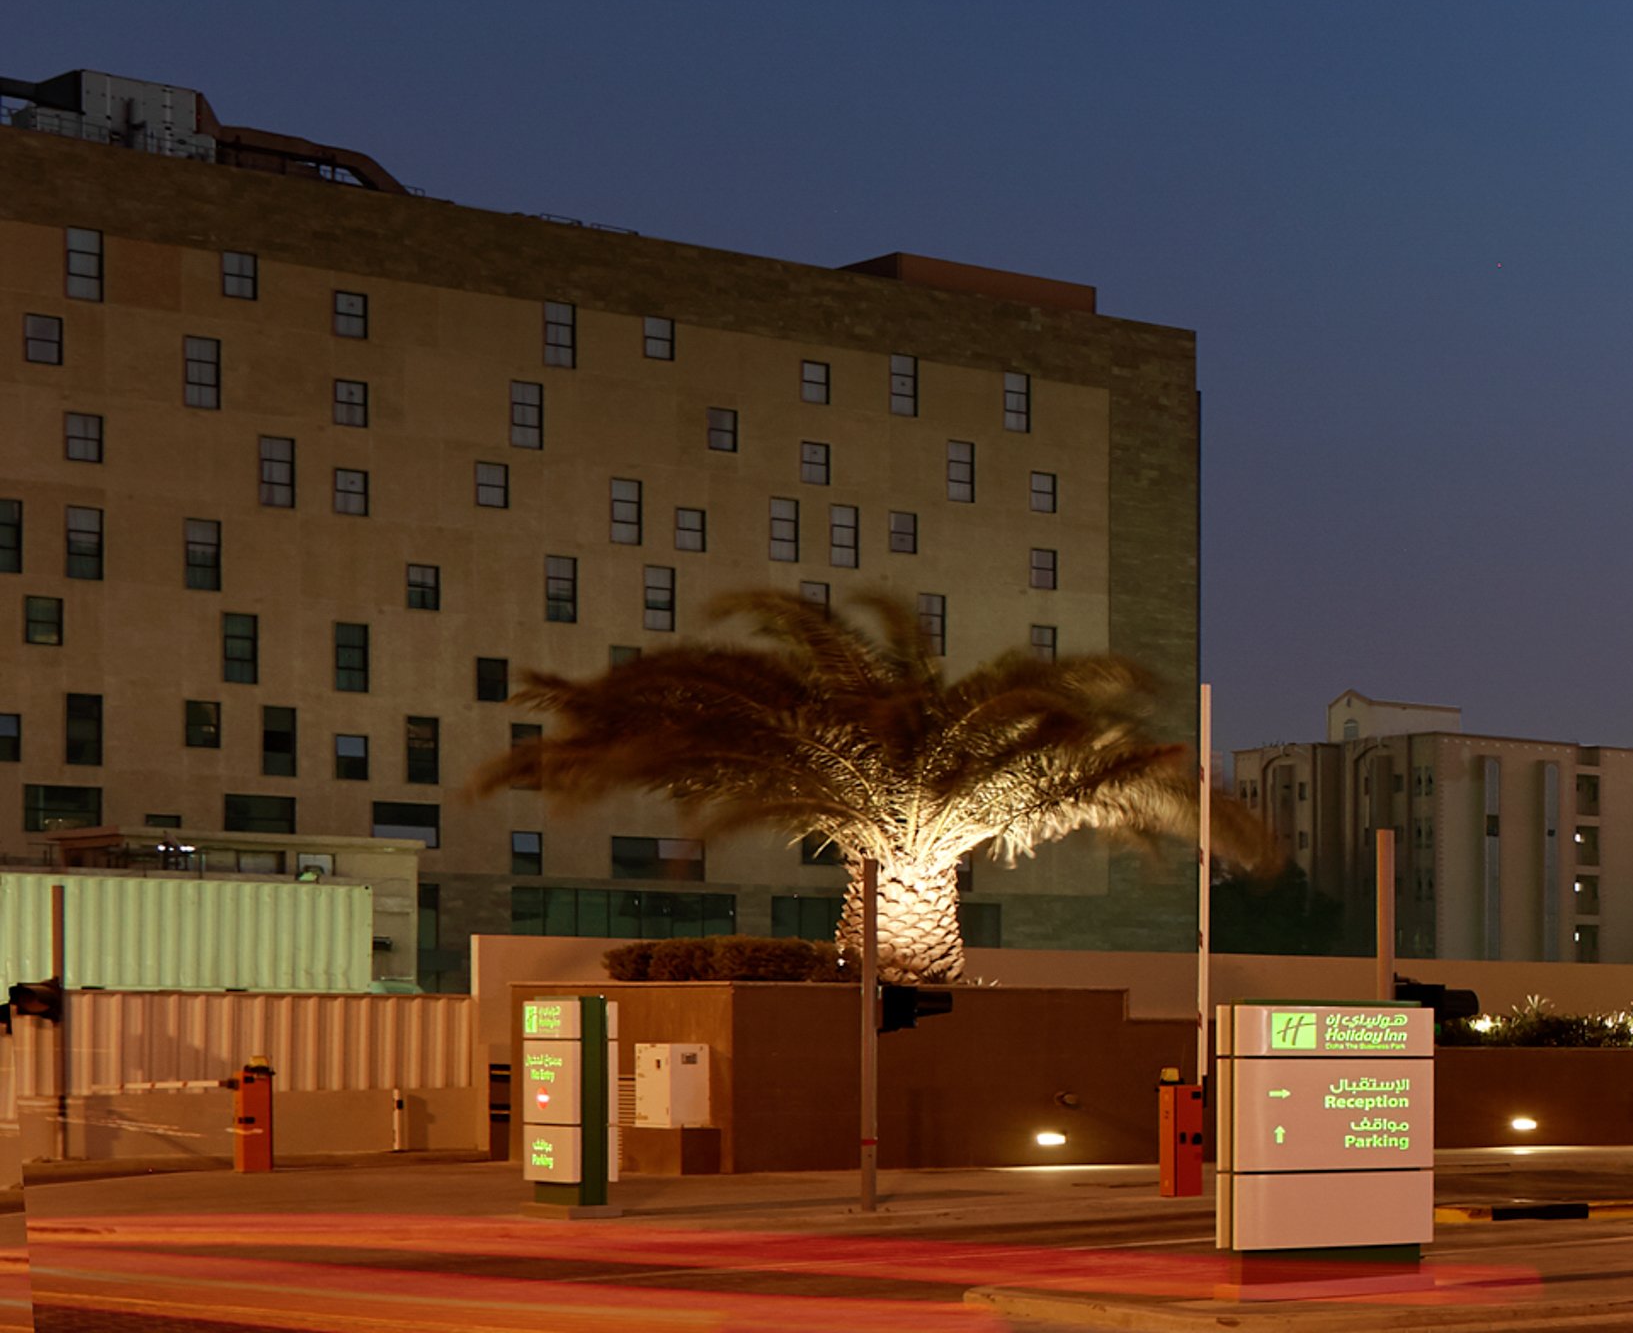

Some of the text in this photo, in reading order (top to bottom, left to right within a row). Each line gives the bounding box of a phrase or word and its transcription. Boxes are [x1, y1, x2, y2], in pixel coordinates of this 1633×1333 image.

[1325, 1027, 1408, 1045] Holiday Inn
[1324, 1095, 1410, 1111] Reception
[1350, 1117, 1410, 1133] مواقف
[1344, 1134, 1410, 1150] Parking
